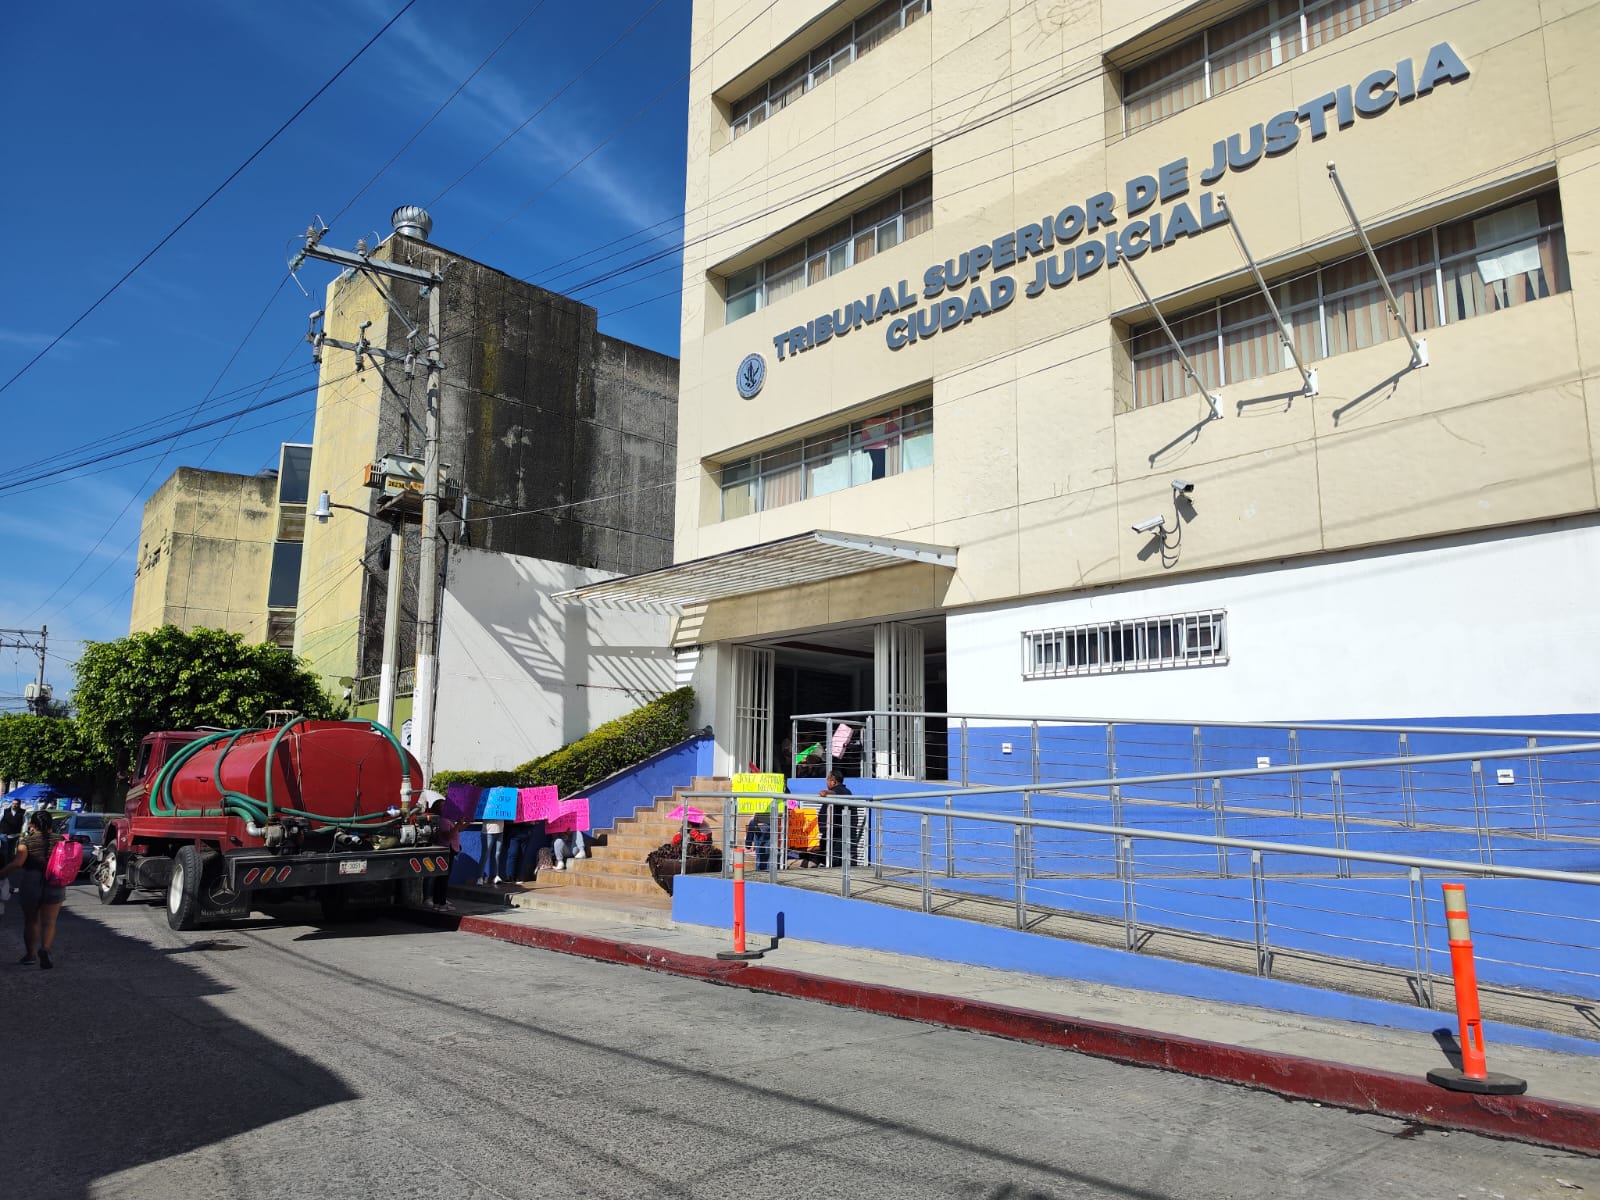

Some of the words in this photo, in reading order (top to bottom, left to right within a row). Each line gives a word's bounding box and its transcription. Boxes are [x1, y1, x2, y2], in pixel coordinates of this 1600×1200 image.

[773, 280, 917, 361] TRIBUNAL
[922, 191, 1116, 300] SUPERIOR
[1125, 157, 1191, 214] DE
[1200, 41, 1471, 185] JUSTICIA
[885, 275, 1017, 351] CIUDAD
[1025, 191, 1230, 299] JUDICIAL
